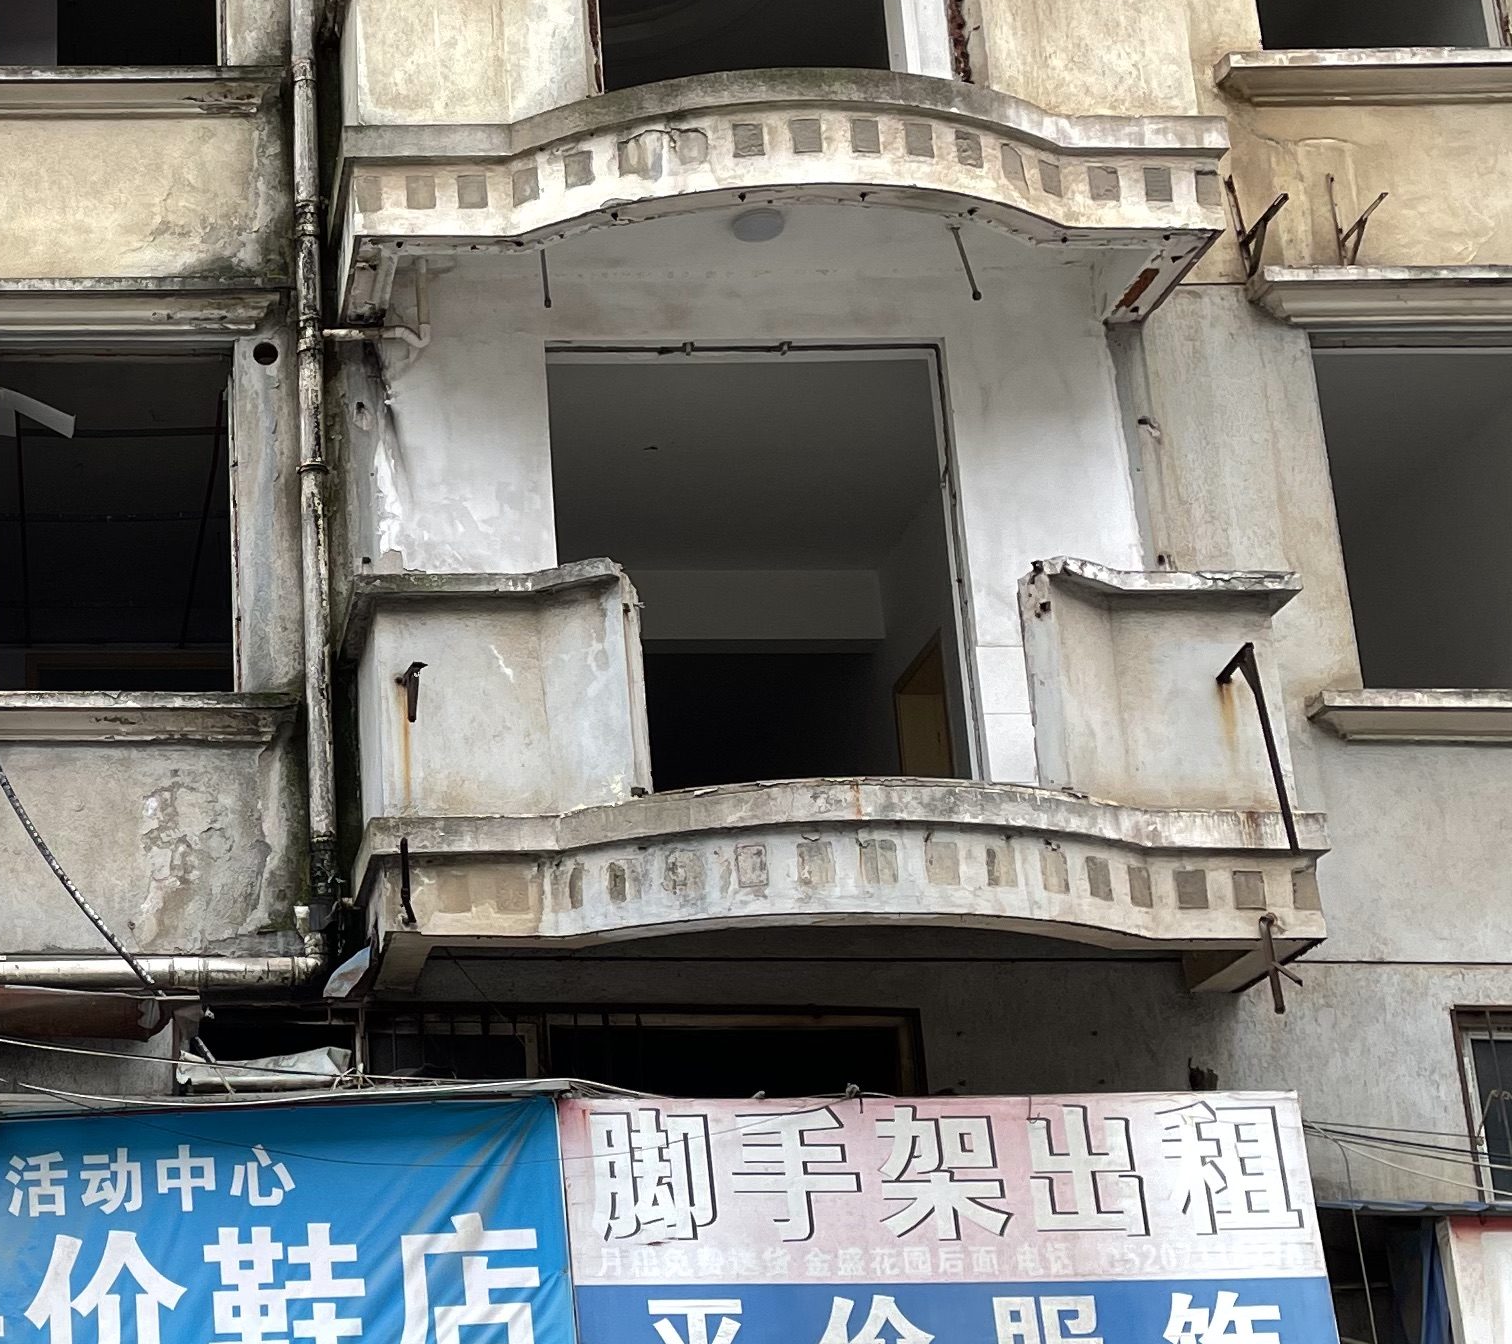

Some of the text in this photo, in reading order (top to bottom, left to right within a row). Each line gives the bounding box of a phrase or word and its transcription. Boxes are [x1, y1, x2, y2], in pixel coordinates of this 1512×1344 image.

[591, 1103, 1304, 1243] 脚手架出租
